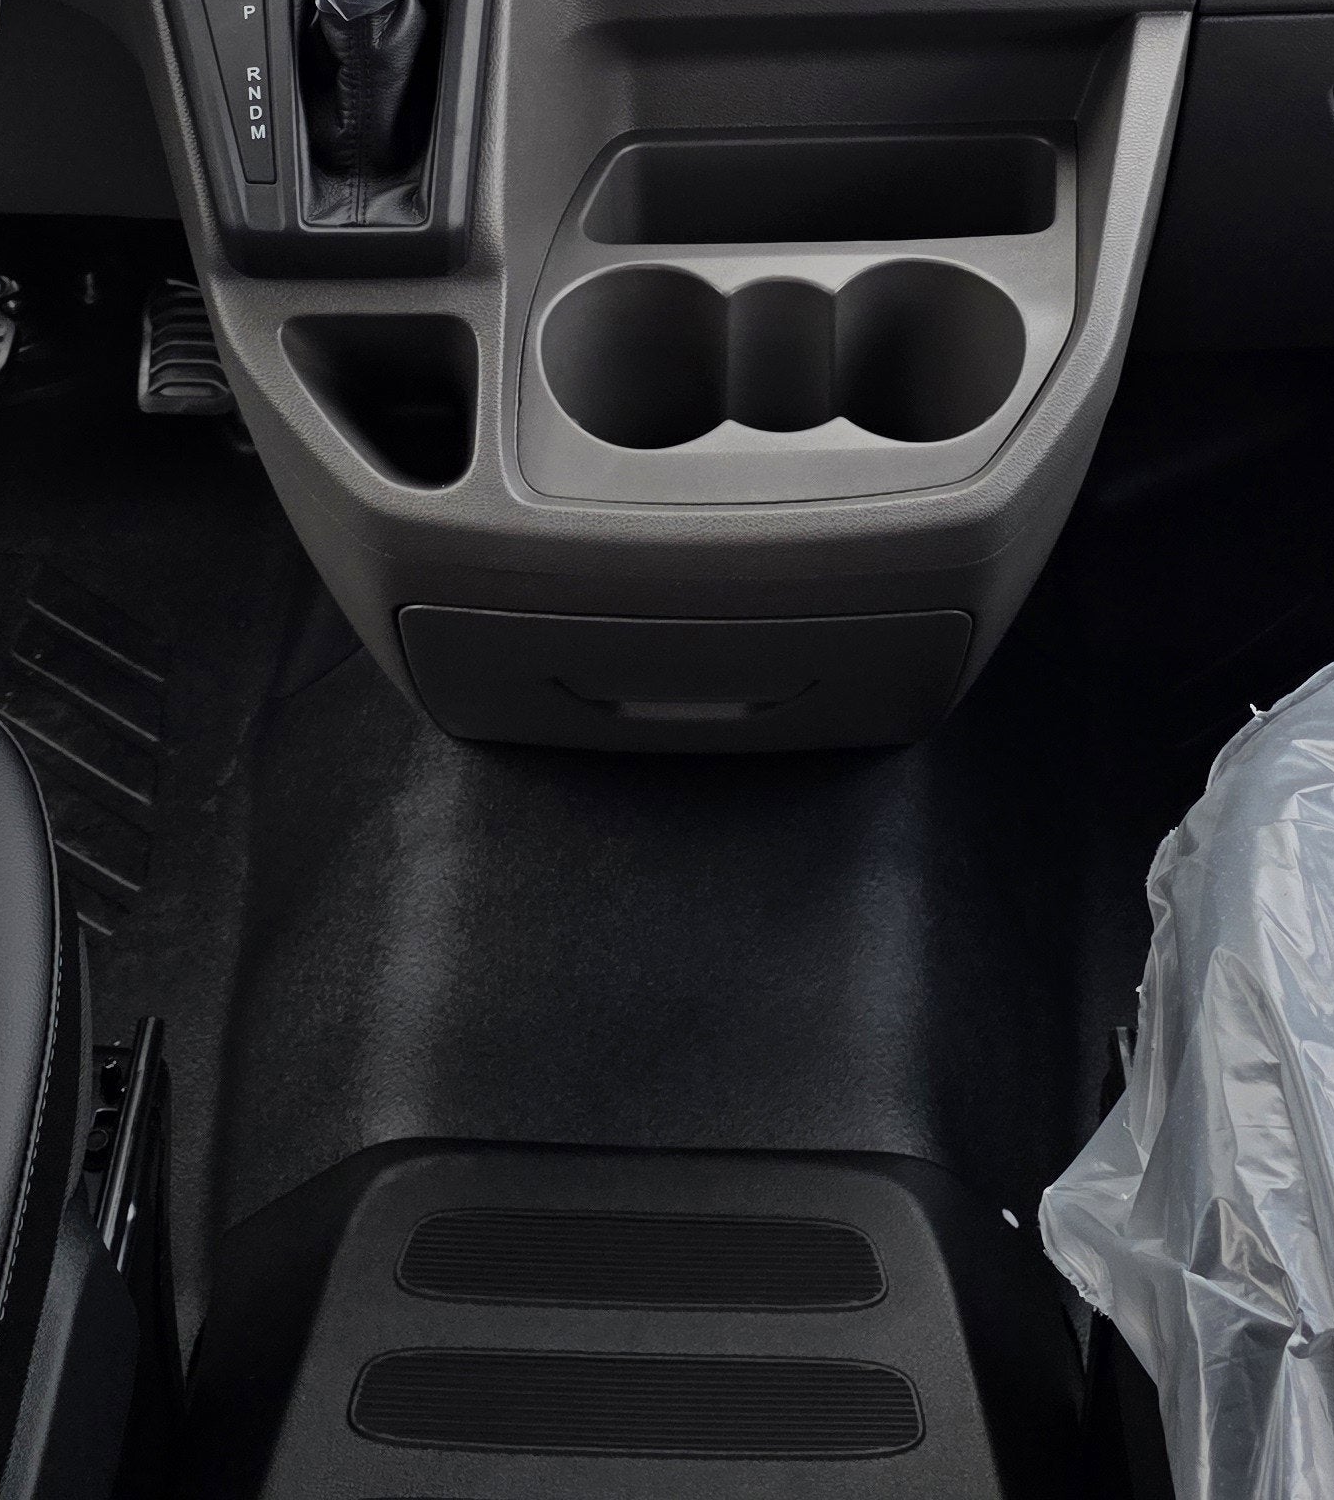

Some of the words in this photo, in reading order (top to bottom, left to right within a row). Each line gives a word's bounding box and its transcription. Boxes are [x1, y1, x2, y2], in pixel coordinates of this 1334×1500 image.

[243, 5, 256, 20] P
[246, 66, 262, 82] R
[248, 85, 262, 101] N
[249, 105, 263, 120] D
[250, 124, 266, 140] M
